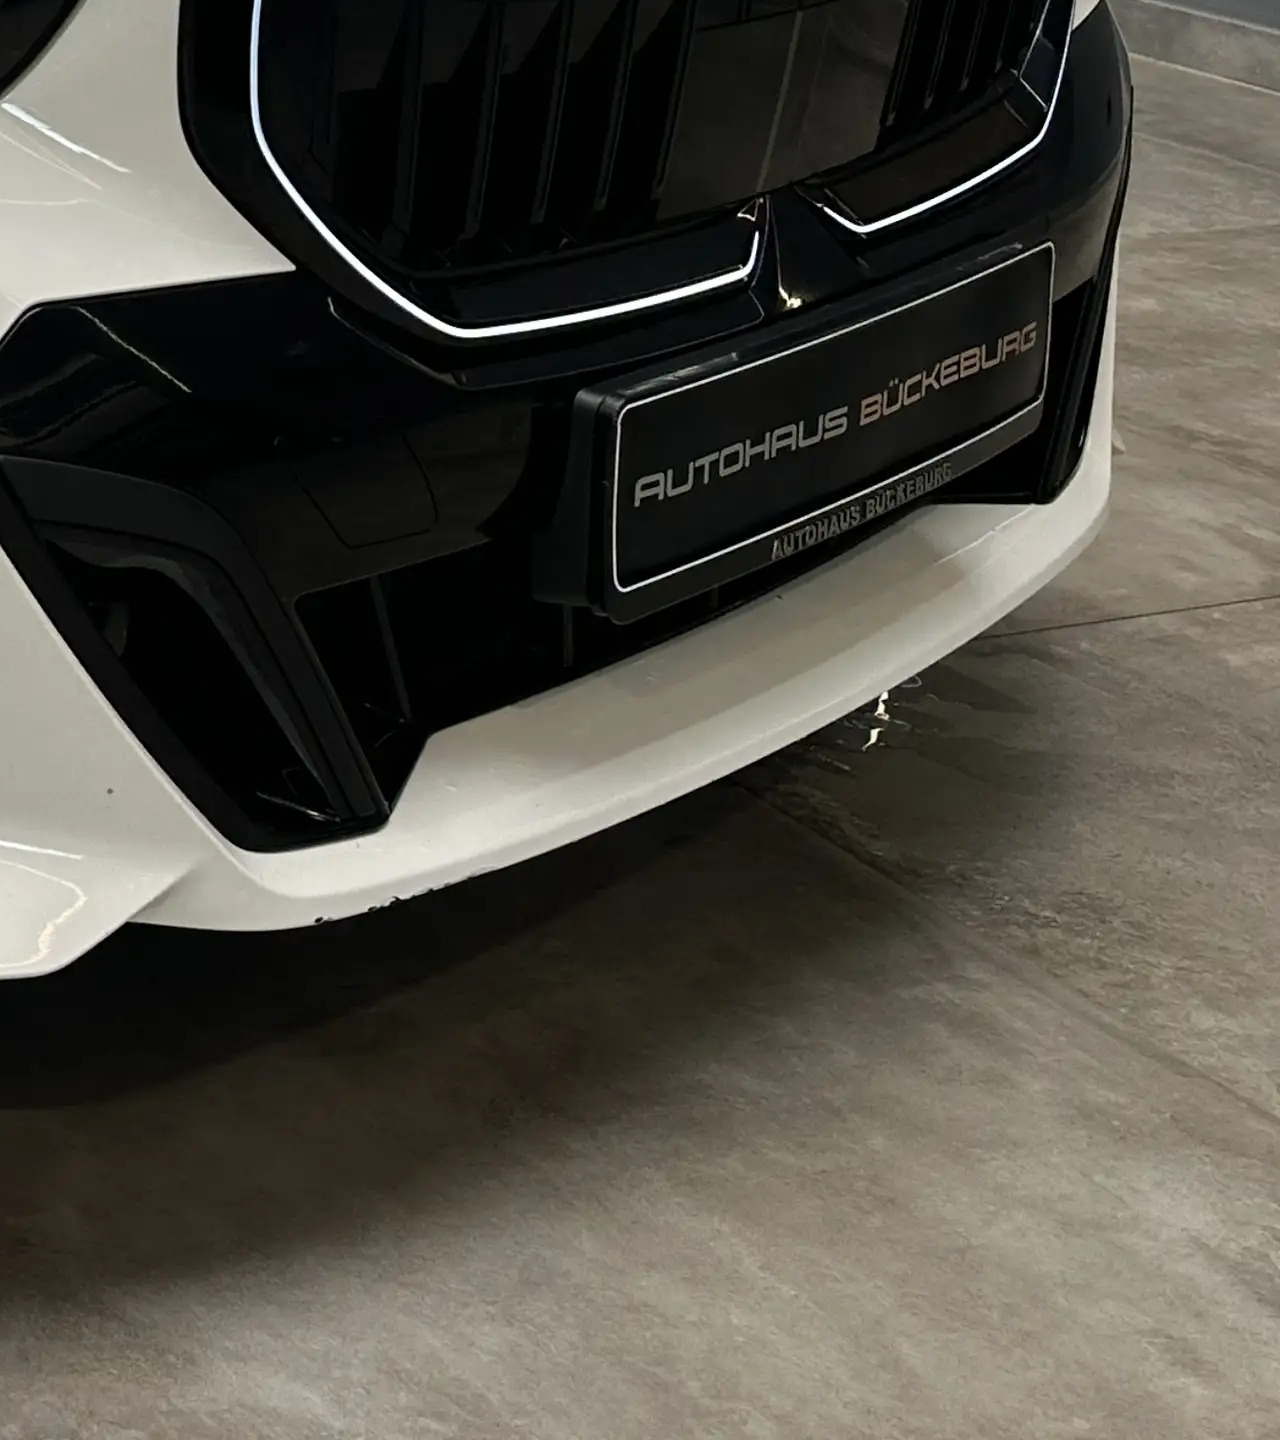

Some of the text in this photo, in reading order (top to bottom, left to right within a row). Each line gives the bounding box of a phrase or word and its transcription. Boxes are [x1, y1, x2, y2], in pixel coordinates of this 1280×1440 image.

[633, 320, 1038, 508] AUTOHAUS BÜCKEBURG
[771, 462, 953, 562] AUTOHAUS BÜCKEBURG
